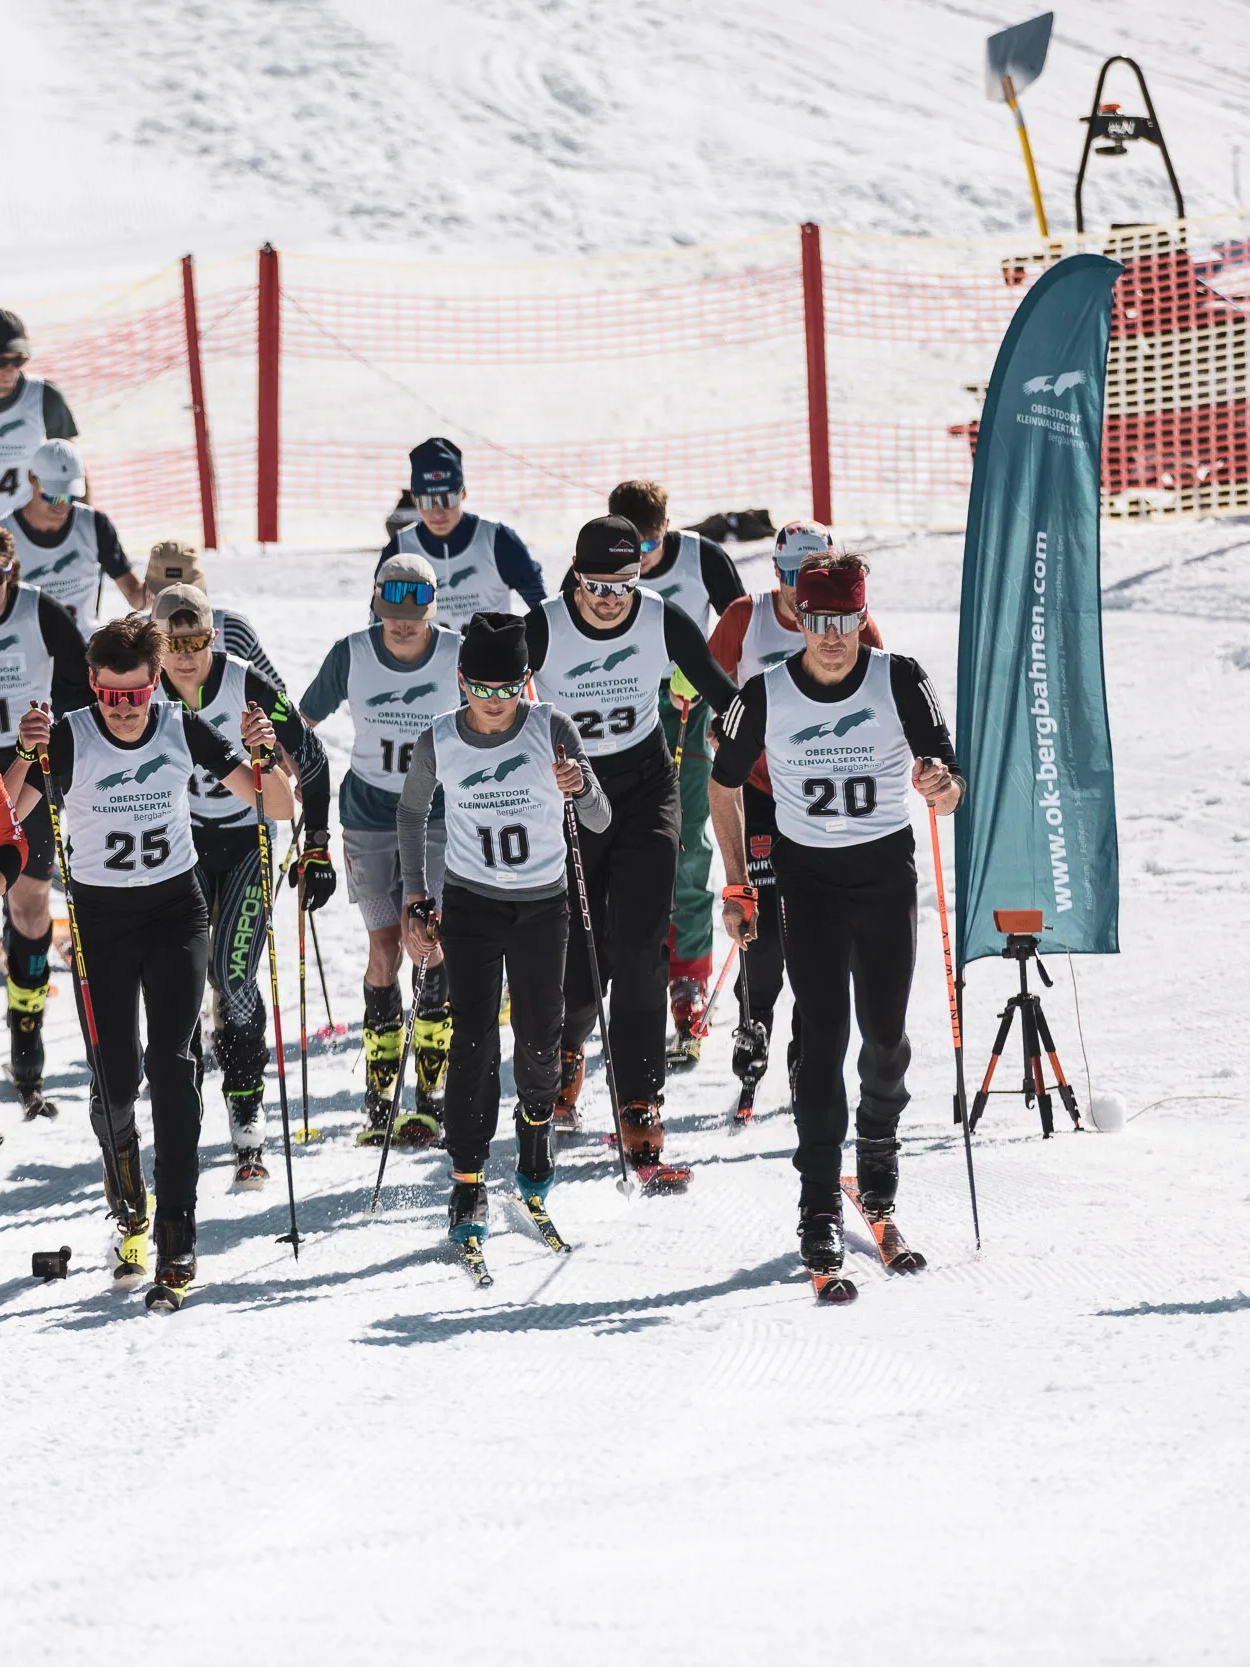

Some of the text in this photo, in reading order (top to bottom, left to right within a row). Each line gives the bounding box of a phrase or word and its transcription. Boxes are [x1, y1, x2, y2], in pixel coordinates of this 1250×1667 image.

[1031, 404, 1082, 424] OBERSTDORF
[1016, 413, 1081, 437] KLEINWALSERTAL
[577, 677, 639, 690] OBERSTDORF
[558, 686, 640, 699] KLEINWALSERTAL
[601, 691, 648, 703] Bergbahnen
[571, 706, 637, 740] 23
[1028, 531, 1073, 913] www.ok-bergbahnen.com
[805, 746, 875, 757] OBERSTDORF
[787, 755, 875, 767] KLEINWALSERTAL
[110, 790, 172, 804] OBERSTDORF
[473, 789, 530, 800] OBERSTDORF
[802, 775, 877, 818] 20
[92, 801, 172, 814] KLEINWALSERTAL
[458, 797, 531, 810] KLEINWALSERTAL
[496, 803, 542, 817] Bergbahnen
[104, 824, 171, 871] 25
[476, 823, 530, 868] 10
[228, 885, 263, 981] KARPOS
